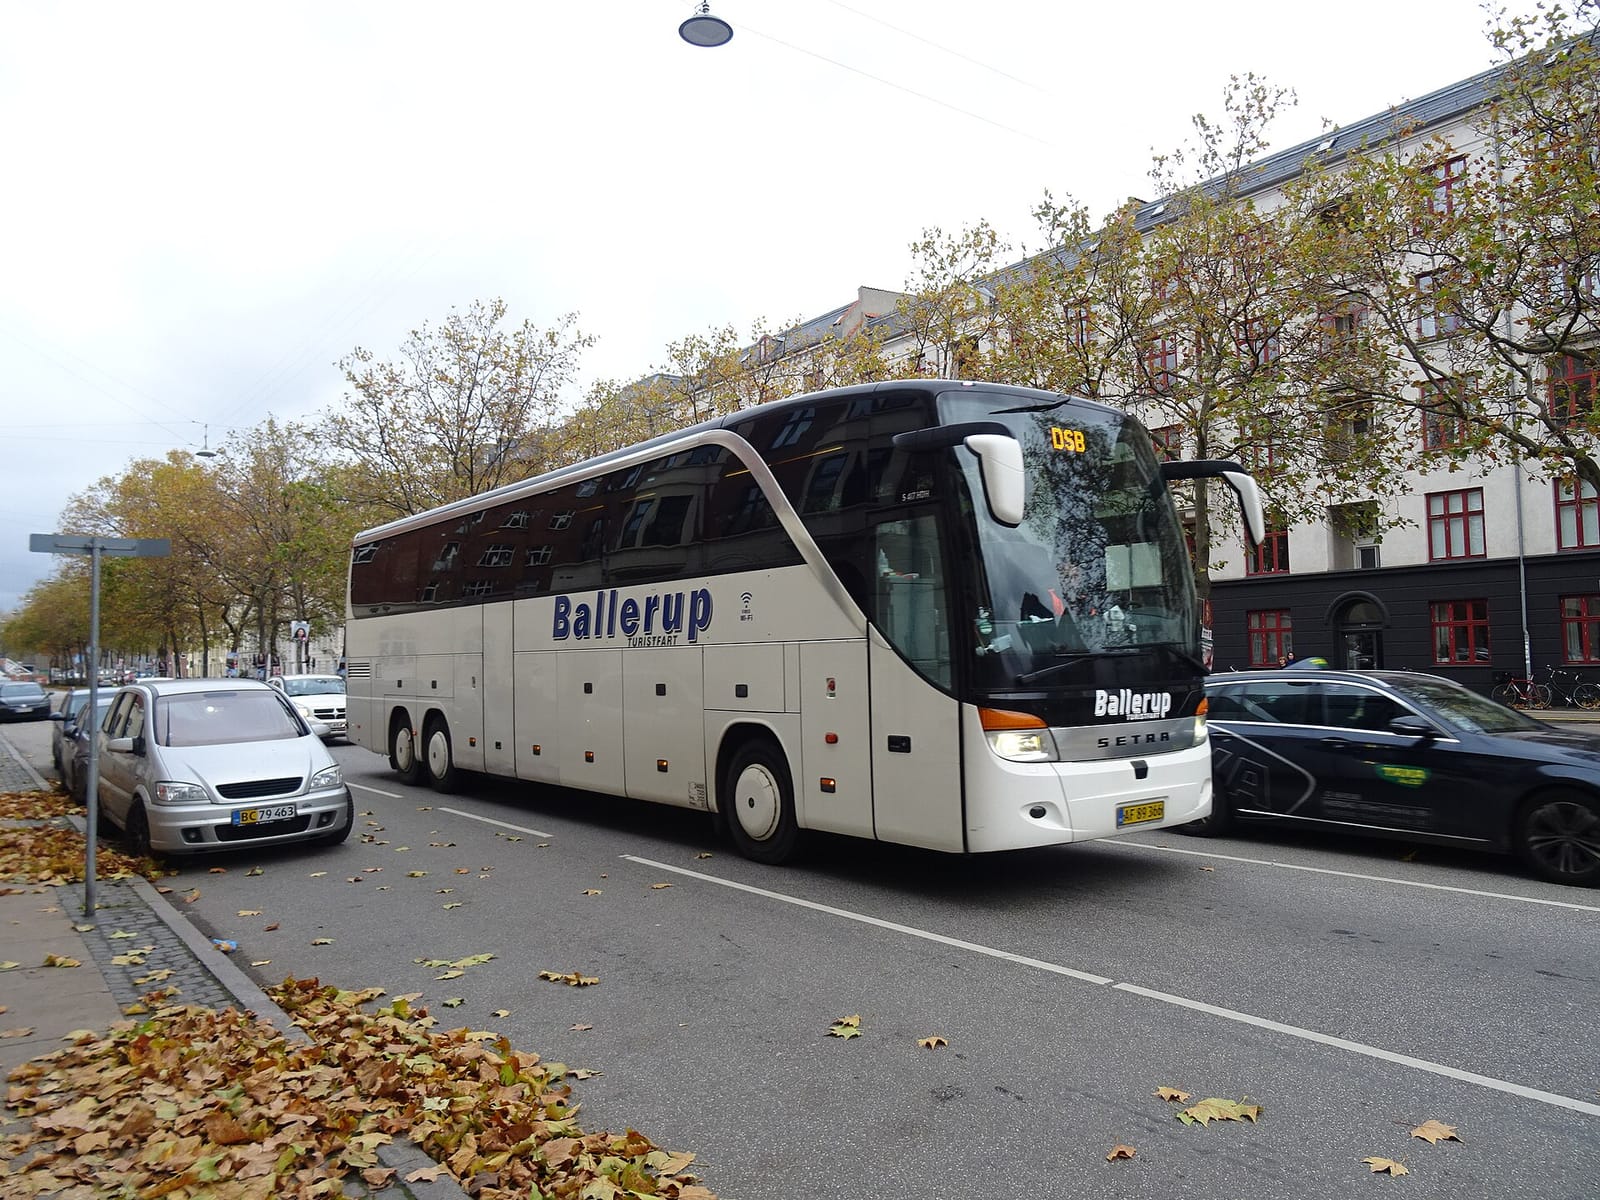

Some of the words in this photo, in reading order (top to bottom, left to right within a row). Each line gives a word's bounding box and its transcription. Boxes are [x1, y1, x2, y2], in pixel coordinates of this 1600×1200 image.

[1051, 426, 1085, 452] DSB
[552, 588, 713, 643] Ballerup
[627, 635, 678, 647] TURISTFART
[1094, 688, 1171, 718] Ballerup
[1097, 732, 1170, 748] SETRA
[241, 811, 257, 822] BC
[259, 809, 272, 820] 79
[274, 806, 294, 817] 463
